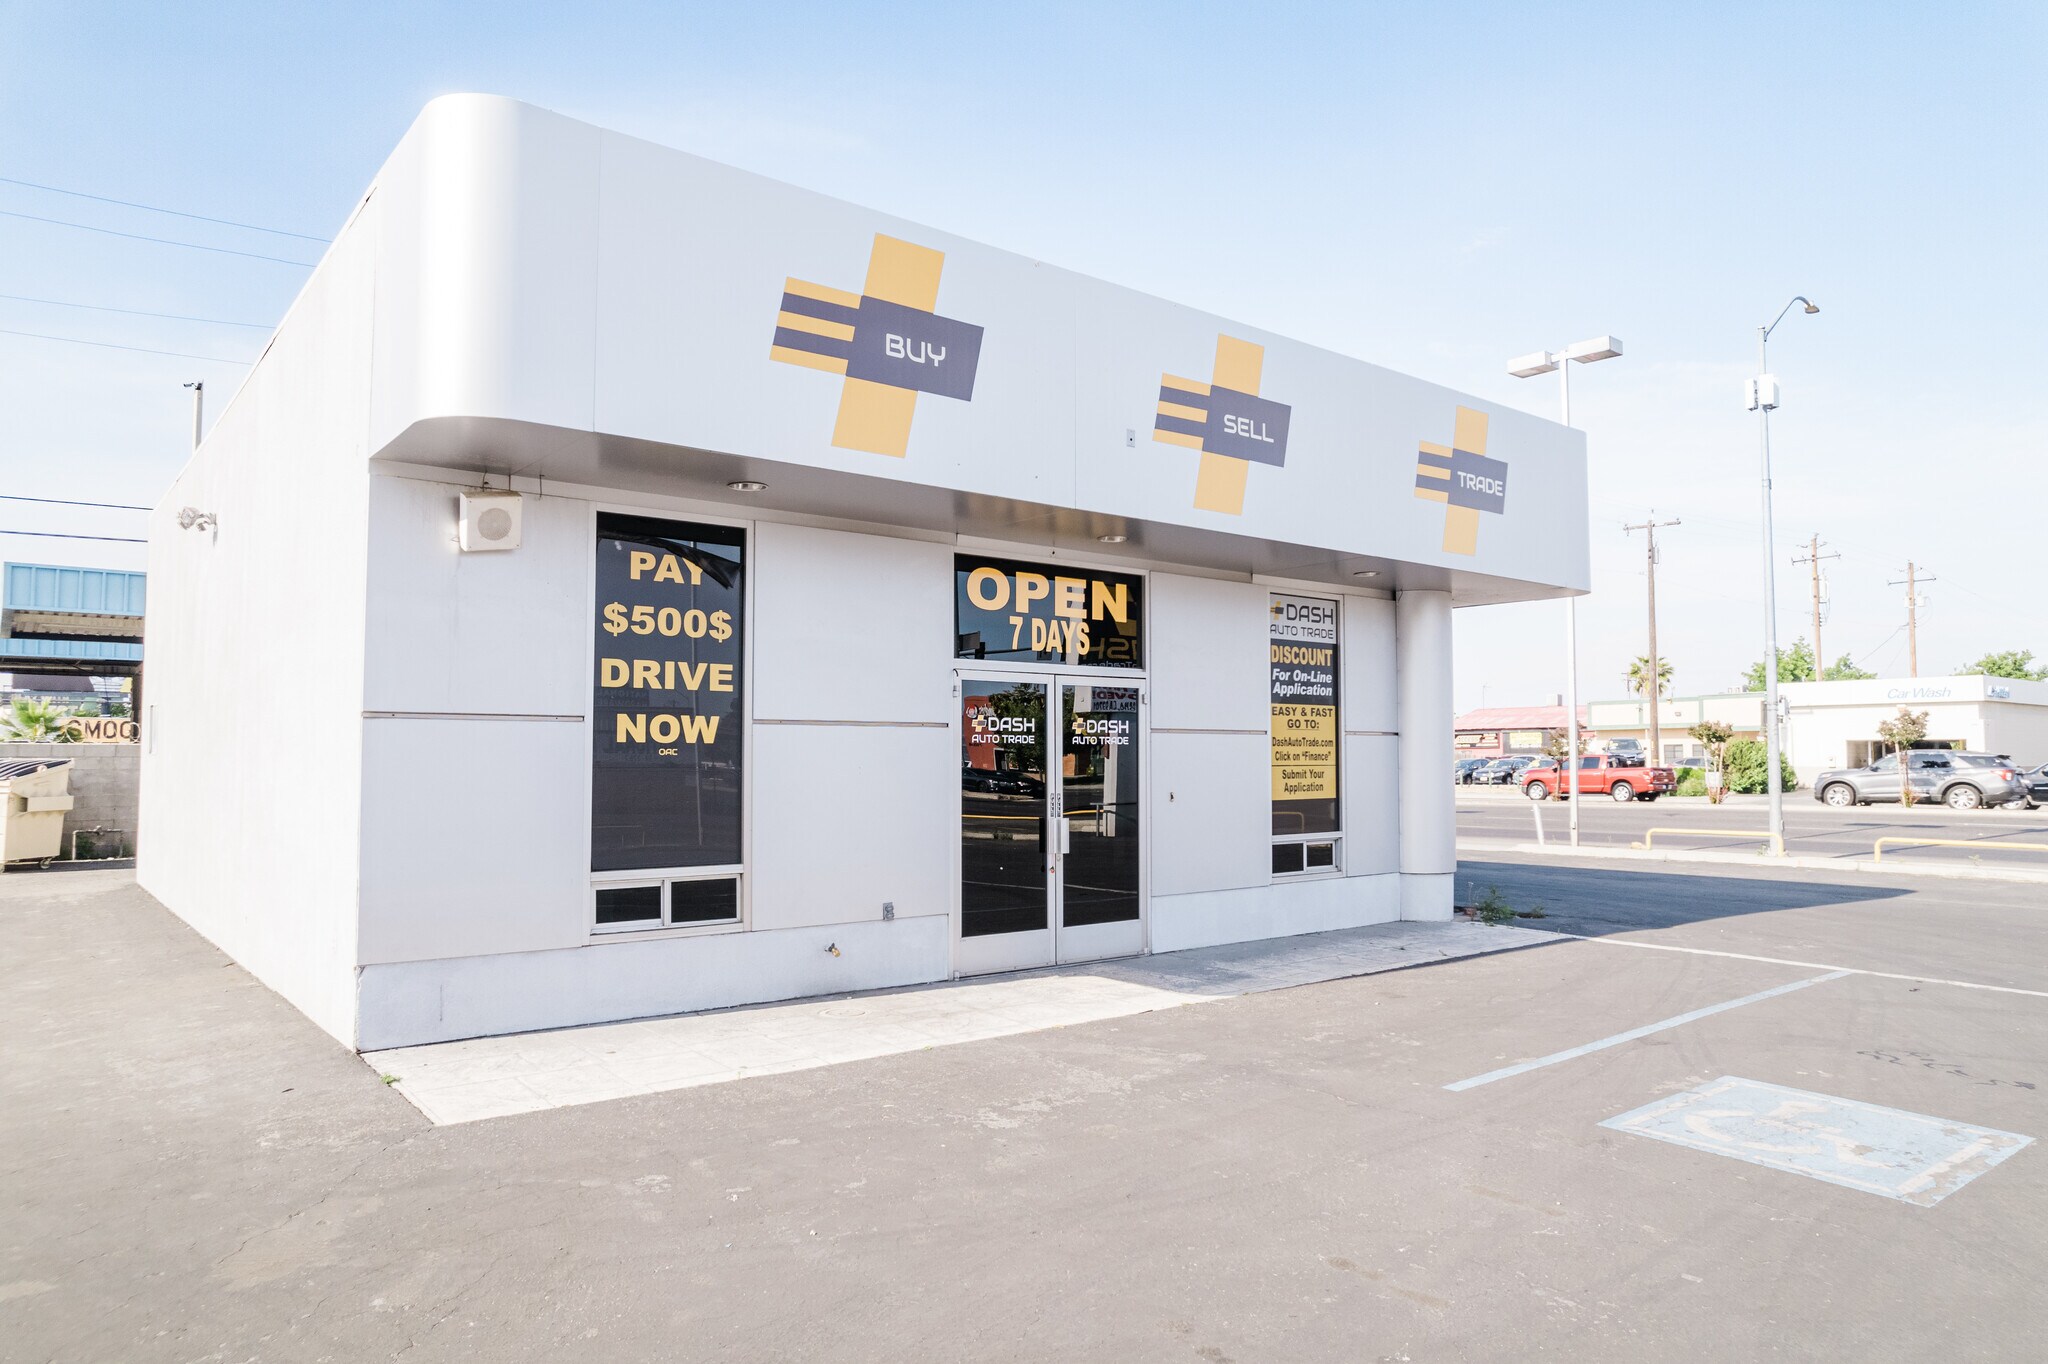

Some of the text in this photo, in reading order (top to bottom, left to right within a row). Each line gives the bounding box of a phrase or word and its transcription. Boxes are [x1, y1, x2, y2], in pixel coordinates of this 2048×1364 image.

[886, 333, 946, 367] BUY
[1223, 414, 1275, 443] SELL
[1457, 471, 1503, 497] TRADE
[630, 550, 704, 586] PAY
[966, 566, 1128, 623] OPEN
[602, 601, 733, 643] $500$
[1286, 603, 1334, 625] DASH
[1009, 616, 1090, 656] 7 DAYS
[1270, 624, 1334, 640] AUTO TRADE
[1271, 644, 1333, 667] DISCOUNT
[600, 657, 734, 693] DRIVE
[1272, 668, 1333, 684] For On-Line
[1272, 682, 1333, 697] Application
[1888, 682, 1952, 699] Car Wash
[1271, 707, 1333, 717] EASY & FAST
[616, 713, 721, 744] NOW
[988, 716, 1036, 732] DASH
[1086, 719, 1129, 734] DASH
[1287, 719, 1320, 729] GO TO:
[971, 734, 1035, 744] AUTO TRADE
[1072, 736, 1129, 745] AUTO TRADE
[1272, 737, 1334, 747] DashAutoTrade.com
[658, 748, 678, 756] OAC
[1275, 751, 1291, 761] Click
[1292, 753, 1300, 761] on
[1282, 769, 1325, 779] Submit Your
[1284, 782, 1324, 794] Application
